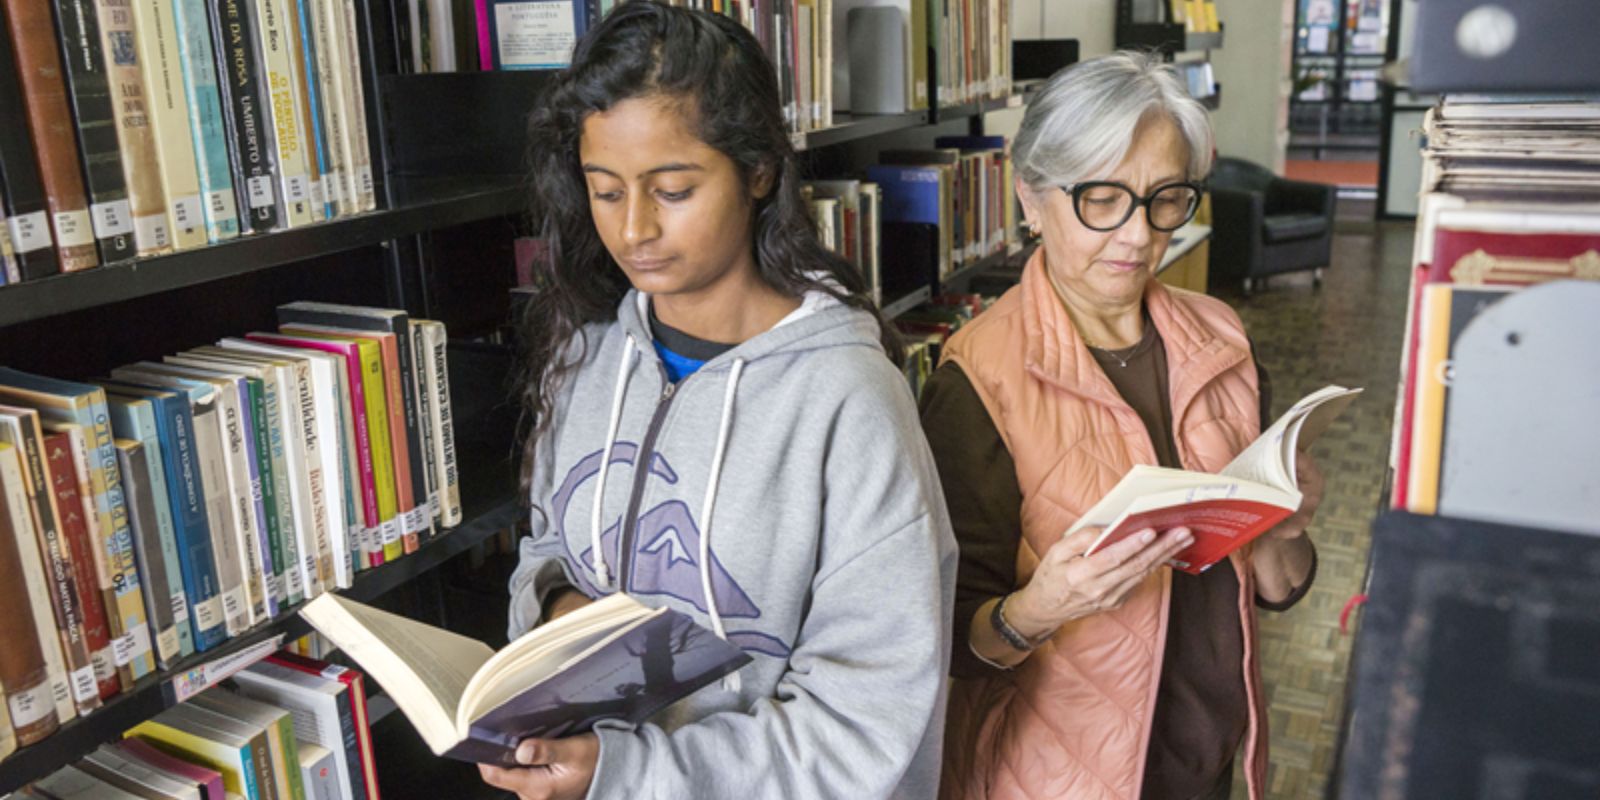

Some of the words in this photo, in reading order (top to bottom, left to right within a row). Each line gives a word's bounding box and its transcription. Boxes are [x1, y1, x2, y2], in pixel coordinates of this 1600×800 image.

[230, 23, 242, 44] DA
[268, 29, 279, 52] Eco
[234, 48, 249, 88] ROSA
[269, 71, 280, 89] DE
[279, 76, 288, 88] O
[240, 95, 260, 163] UMBERTO
[271, 93, 291, 160] FOUCAULT
[281, 90, 298, 151] PÊNDULO
[297, 366, 317, 451] Senilidade
[96, 414, 126, 520] PIRANDELLO
[309, 468, 323, 506] Italo
[47, 530, 55, 540] O
[314, 505, 327, 550] Svevo
